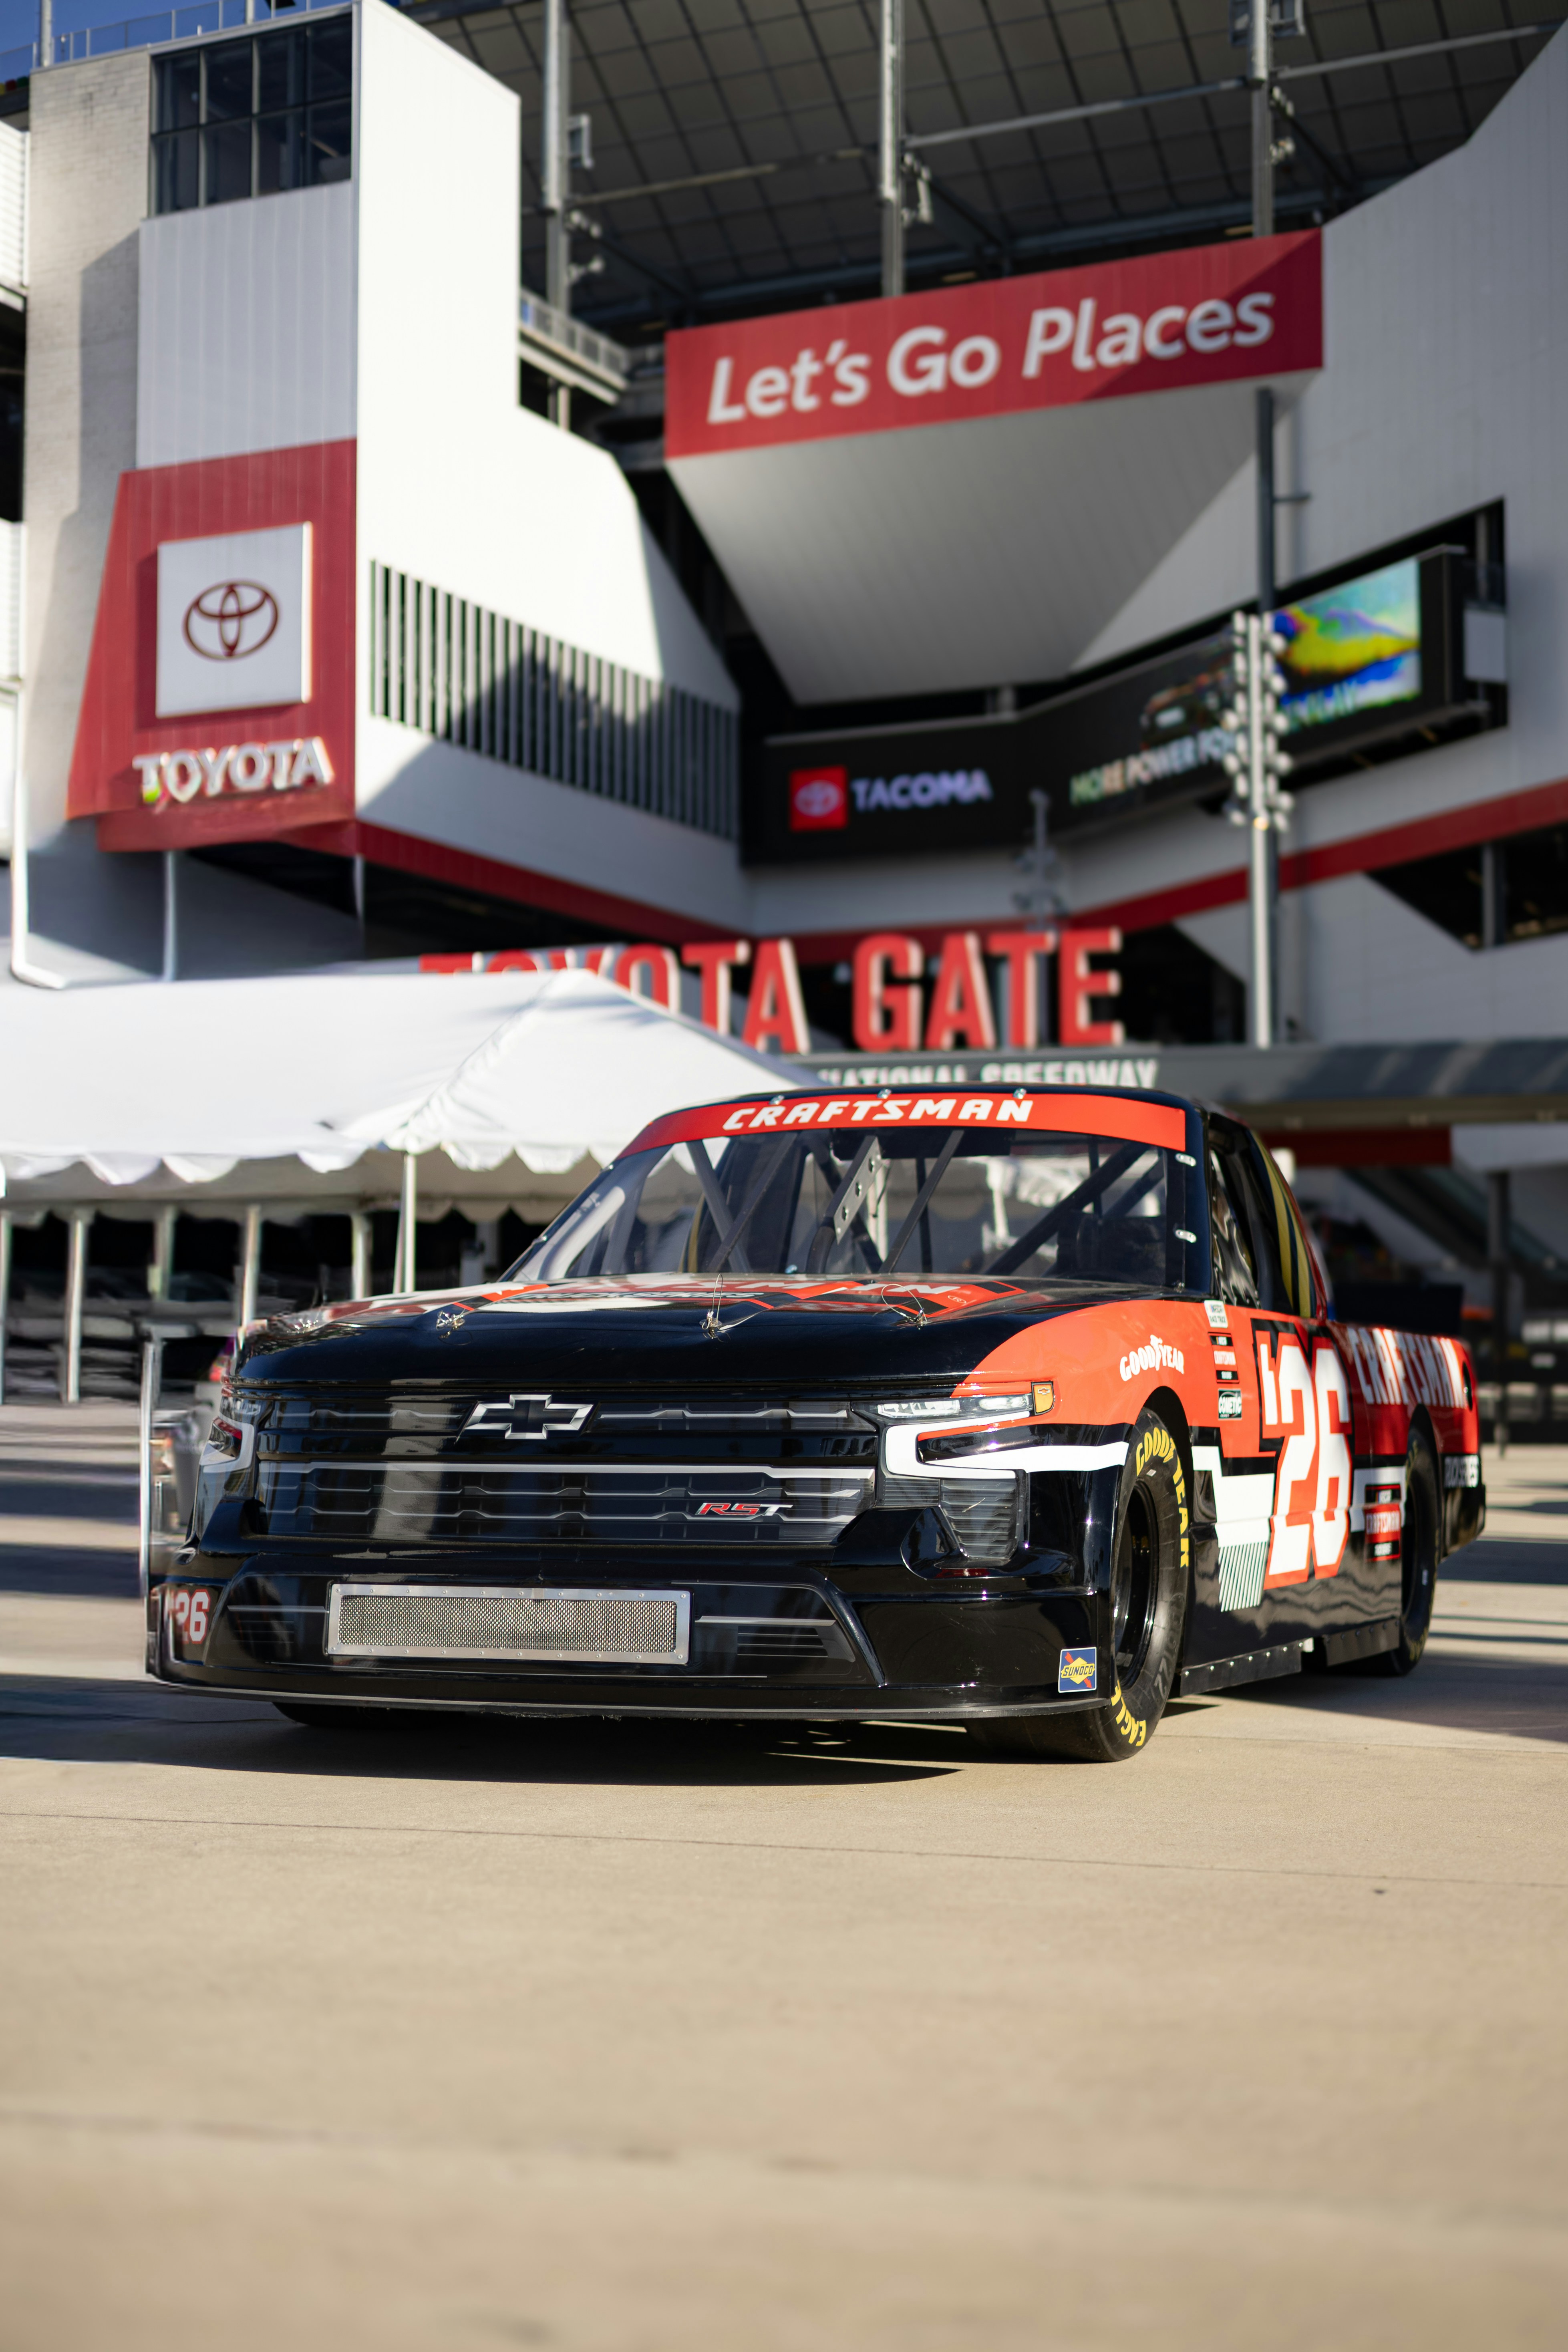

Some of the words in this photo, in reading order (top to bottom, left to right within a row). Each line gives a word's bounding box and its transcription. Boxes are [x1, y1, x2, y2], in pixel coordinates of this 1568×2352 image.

[707, 335, 872, 425] Let's
[886, 325, 1000, 397] Go
[1022, 292, 1276, 379] Places
[133, 736, 336, 803] TOYOTA
[1125, 735, 1198, 787] POWER
[850, 768, 993, 813] TACOMA
[853, 927, 1123, 1053] GATE
[980, 1059, 1157, 1089] SPEEDWAY
[722, 1099, 1033, 1131] CRAFTSMAN
[1119, 1340, 1184, 1381] GOODYEAR
[1347, 1327, 1465, 1409] CRAFTSMAN
[1218, 1396, 1242, 1414] COMETIC
[694, 1502, 793, 1516] RST
[1136, 1427, 1189, 1568] GOODYEAR
[1063, 1665, 1093, 1676] SUNOCO
[1111, 1679, 1147, 1746] EAGLE
